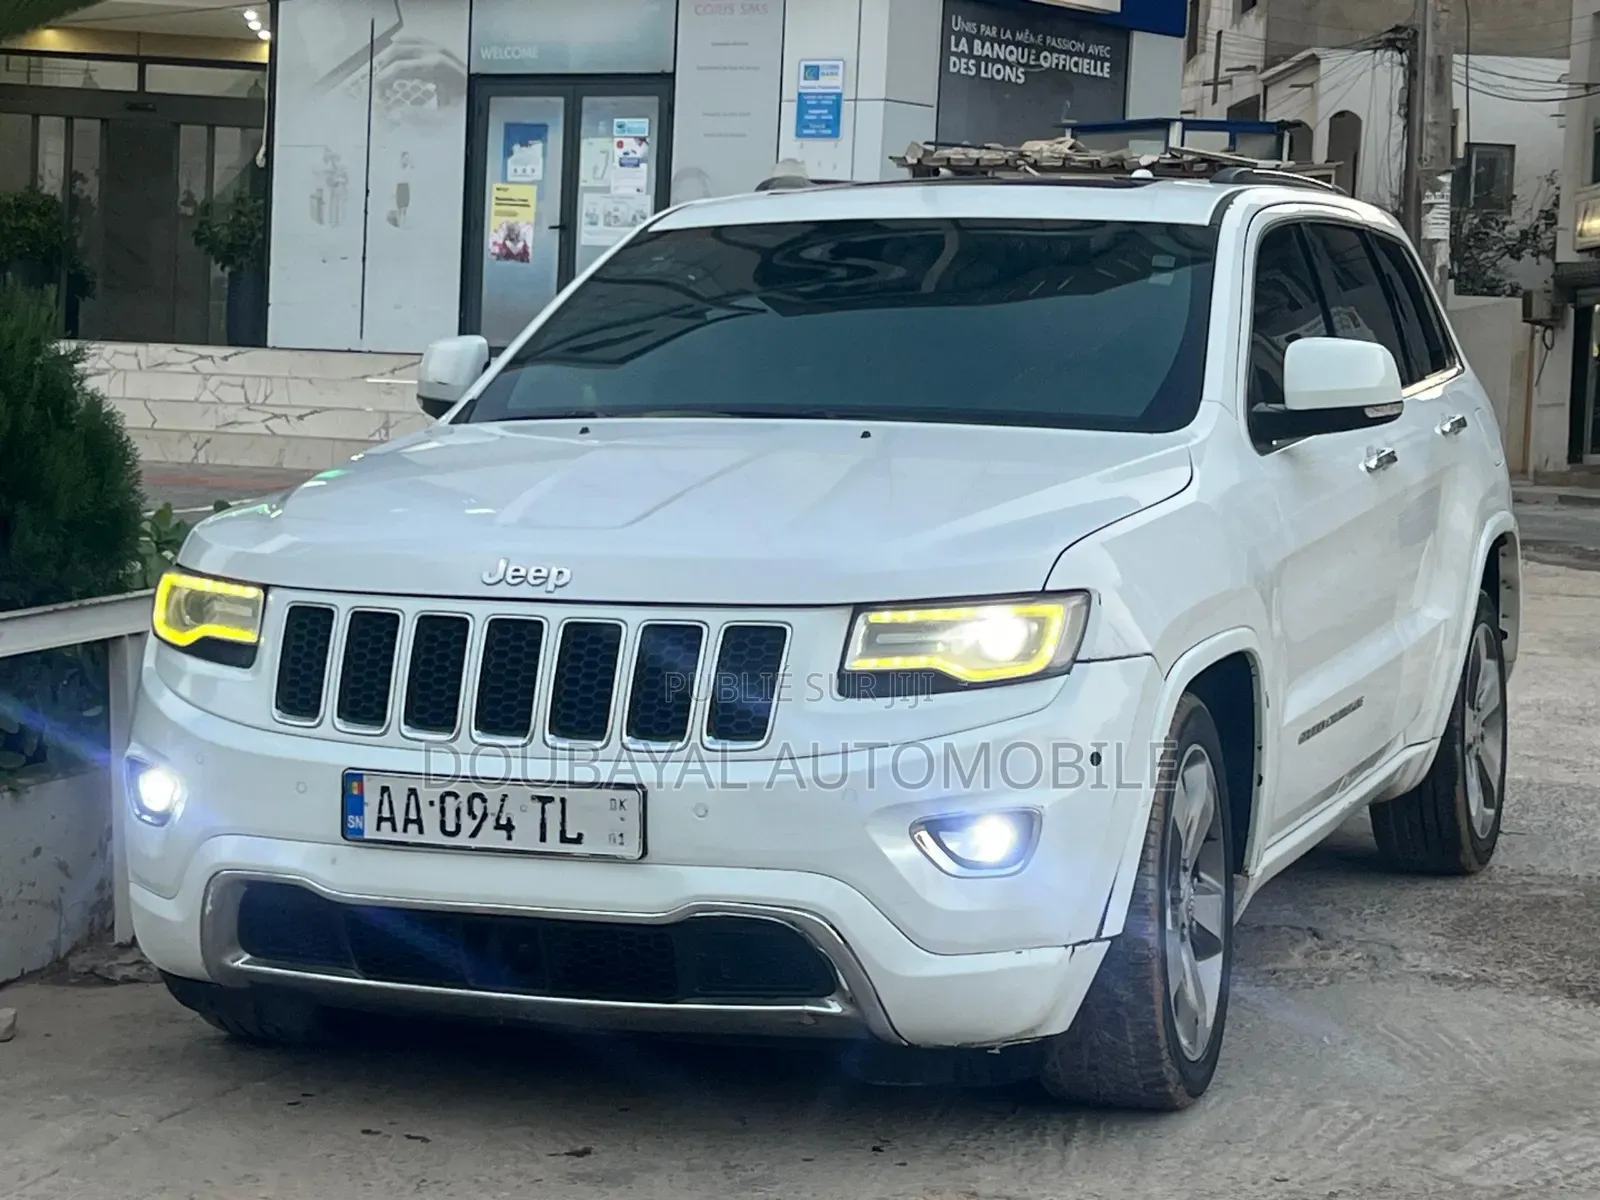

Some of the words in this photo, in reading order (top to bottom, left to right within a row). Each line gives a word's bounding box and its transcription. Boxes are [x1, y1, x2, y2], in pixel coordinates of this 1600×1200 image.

[480, 45, 540, 60] WELCOME
[950, 35, 969, 55] LA
[973, 38, 1037, 66] BANQUE
[1040, 51, 1111, 79] OFFICIELLE
[980, 24, 998, 38] PAR
[1000, 27, 1013, 41] LA
[1046, 35, 1086, 53] PASSION
[1087, 43, 1111, 58] AVEC
[949, 55, 977, 77] DES
[980, 60, 1026, 85] LIONS
[481, 558, 571, 593] Jeep
[376, 785, 425, 835] AA
[439, 790, 516, 842] 094
[531, 794, 585, 845] TL
[609, 797, 628, 812] DK
[347, 815, 364, 830] SN
